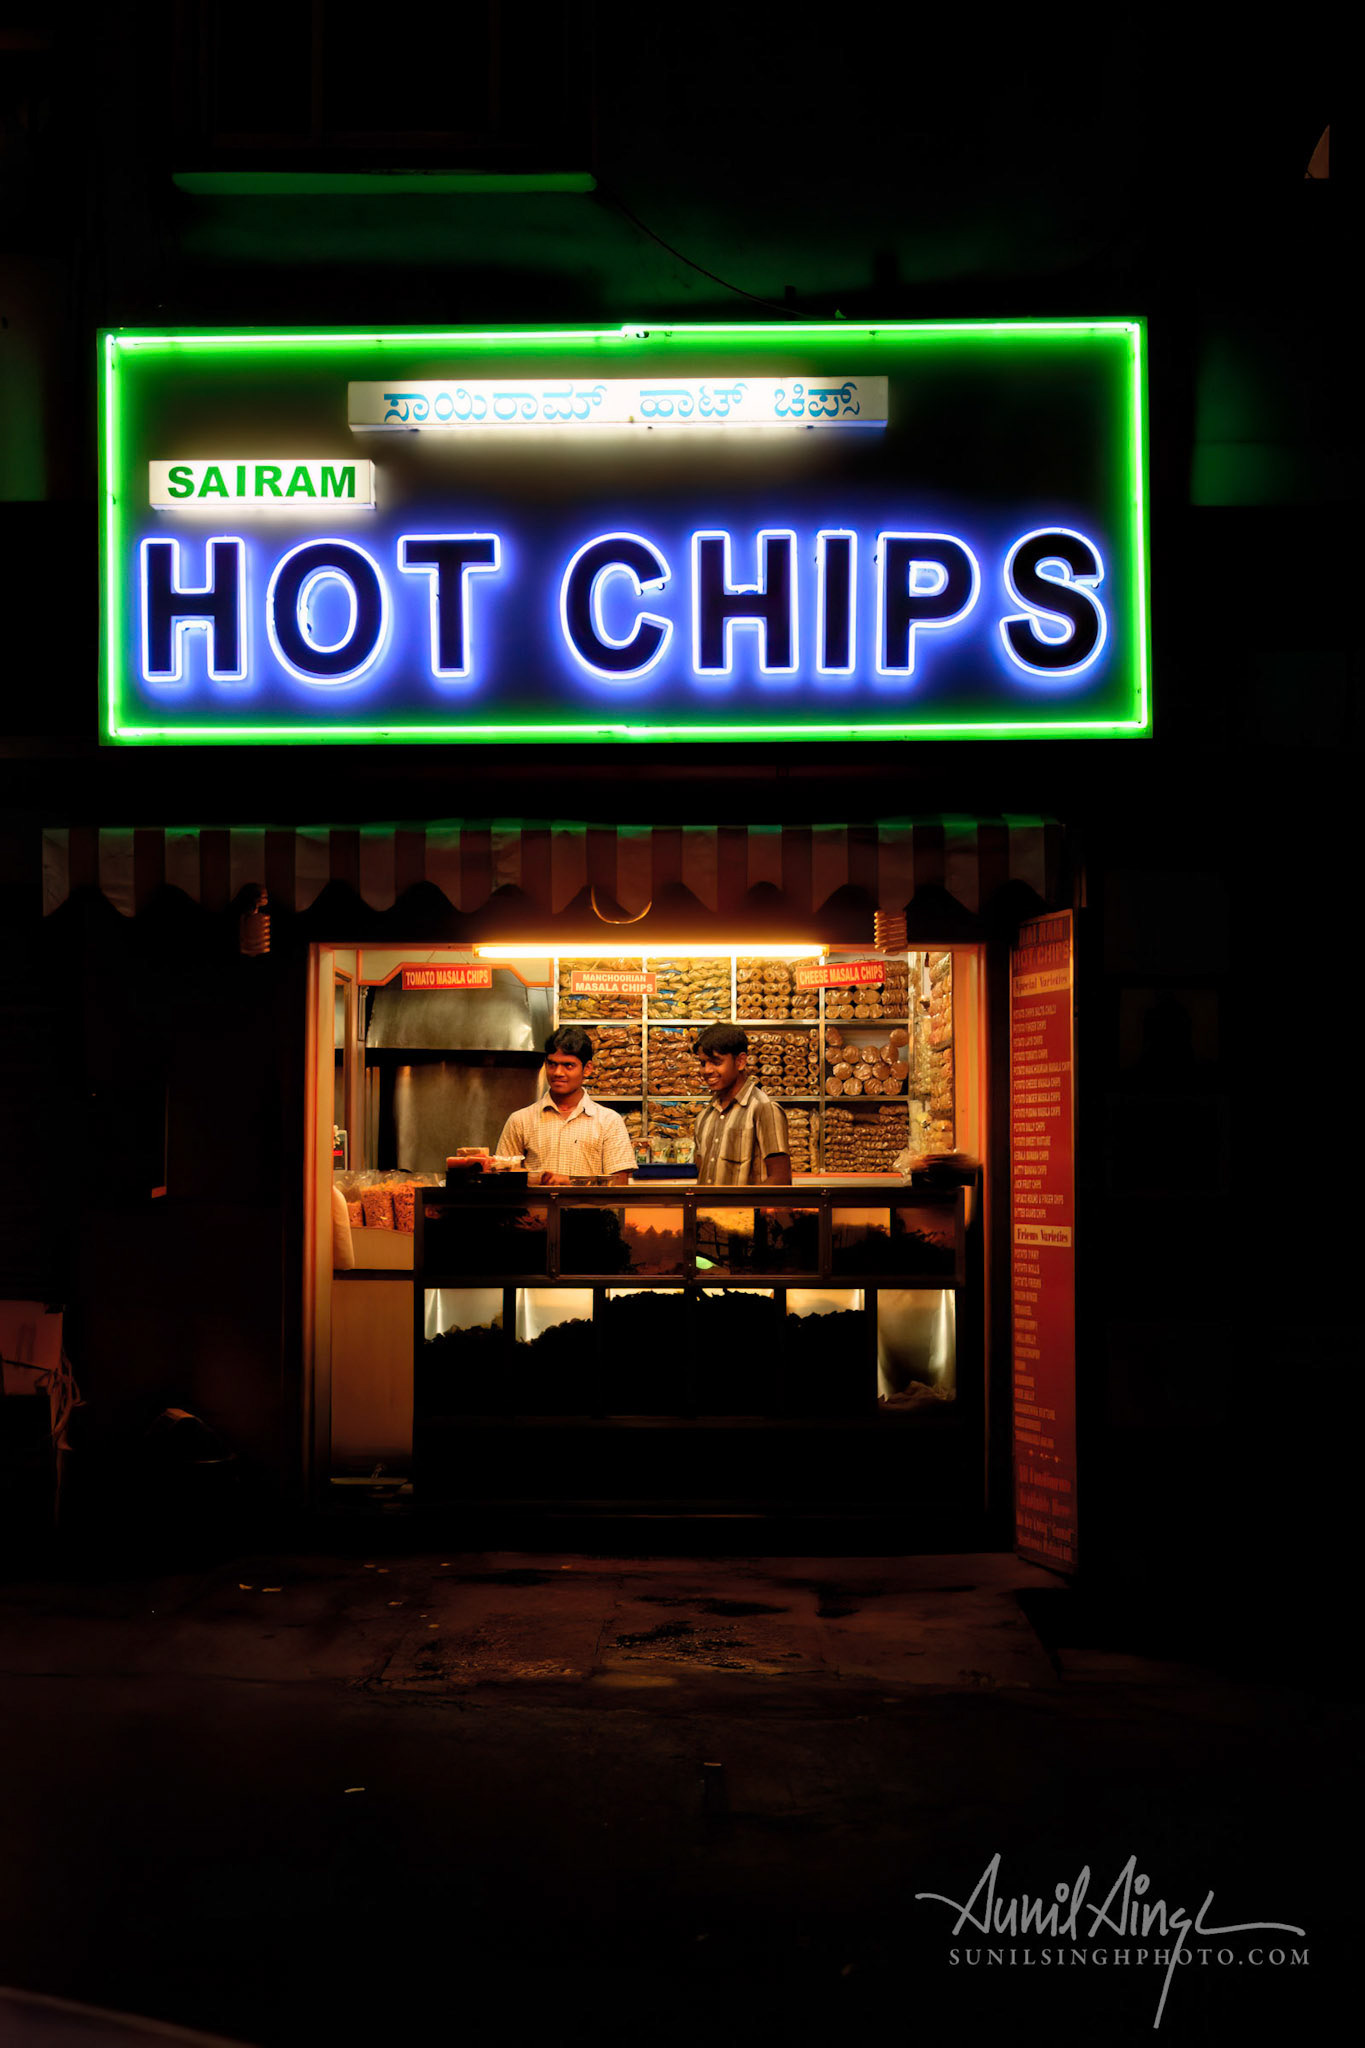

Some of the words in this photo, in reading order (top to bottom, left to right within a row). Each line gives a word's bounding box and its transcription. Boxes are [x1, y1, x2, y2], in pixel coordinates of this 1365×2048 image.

[383, 385, 607, 423] ಸಾಯಿರಾಮ್
[639, 382, 748, 419] ಹಾಟ್
[167, 466, 356, 498] SAIRAM
[140, 533, 501, 685] HOT
[559, 527, 1108, 680] CHIPS
[405, 971, 436, 986] TOMATO
[436, 970, 466, 985] MASALA
[466, 969, 489, 984] CHIPS
[582, 973, 647, 983] MANCHOORIAN
[799, 969, 829, 985] CHEESE
[829, 967, 860, 983] MASALA
[860, 965, 884, 981] CHIPS
[575, 982, 618, 992] MASALA
[621, 982, 654, 993] CHIPS
